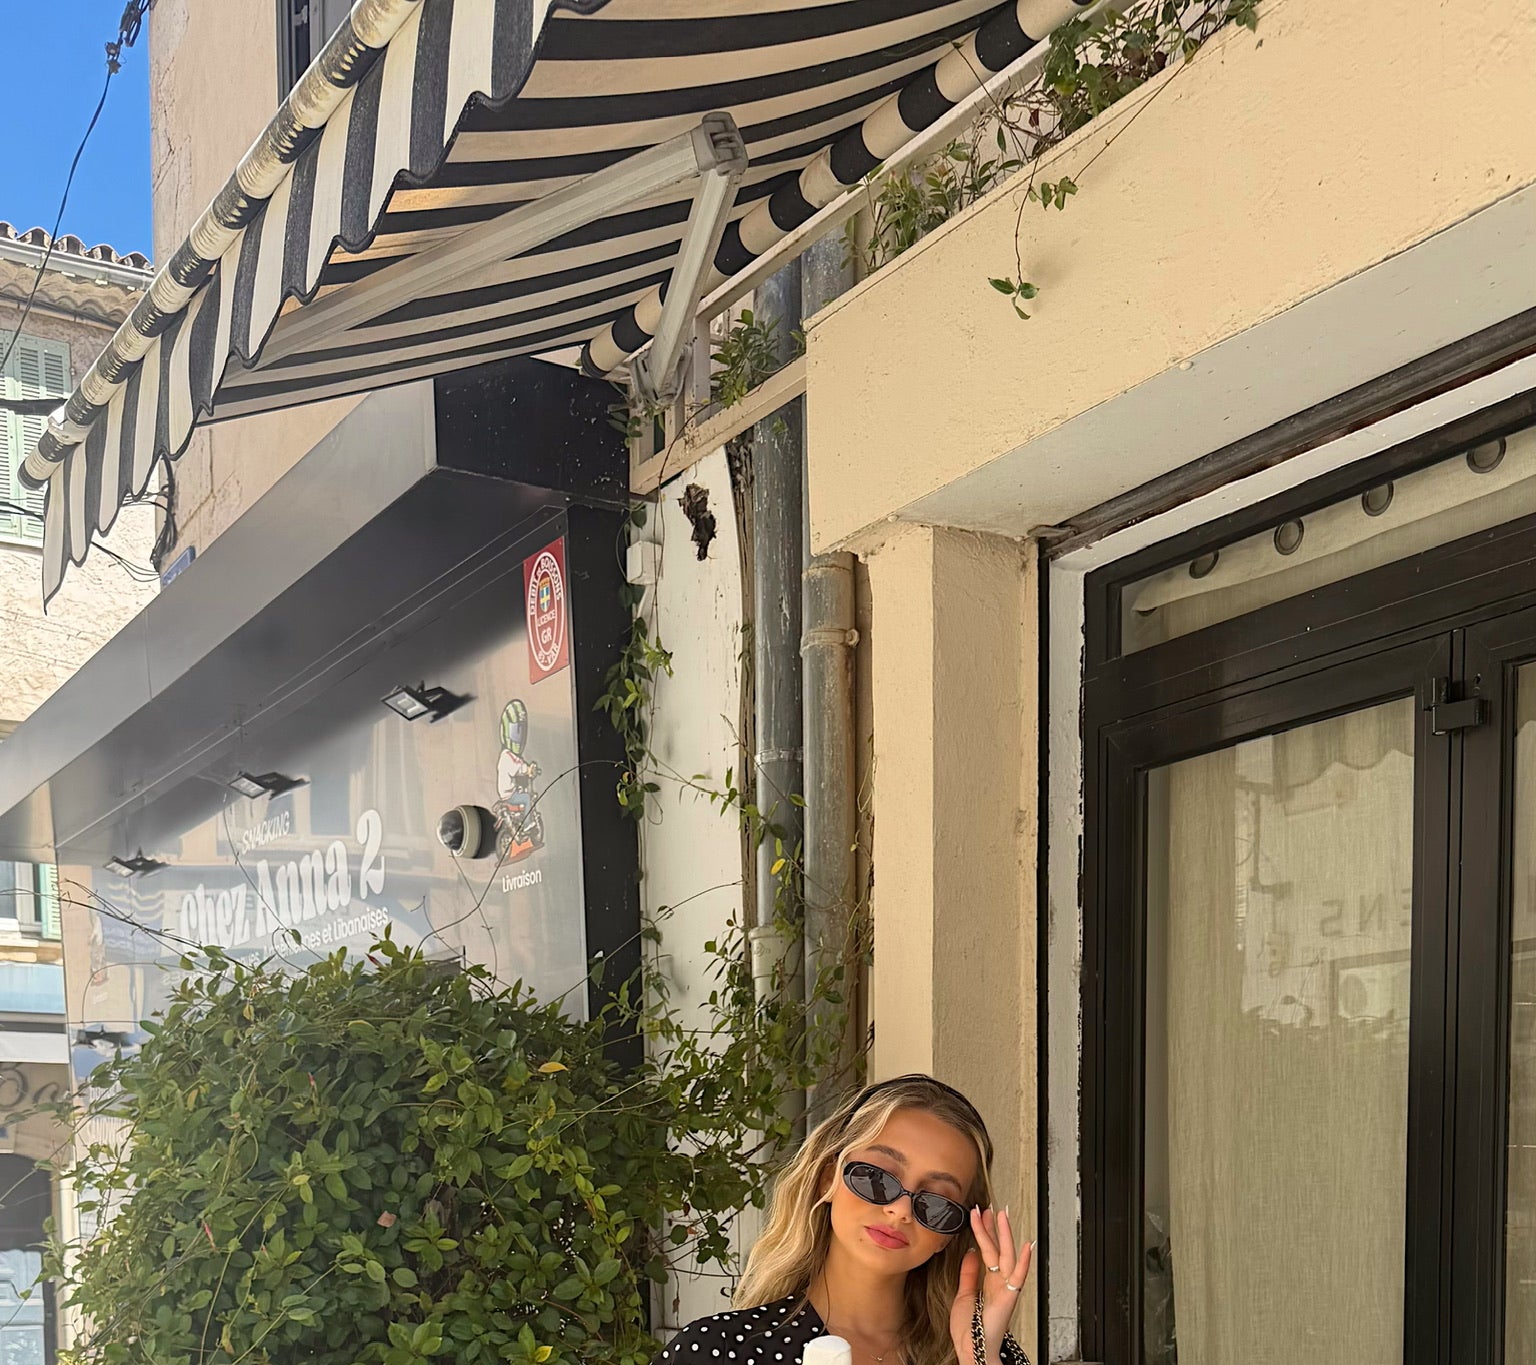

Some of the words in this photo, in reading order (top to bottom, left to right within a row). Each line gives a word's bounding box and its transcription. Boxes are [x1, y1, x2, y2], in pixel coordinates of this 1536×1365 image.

[537, 609, 557, 628] LICENCE
[541, 627, 552, 645] GR
[242, 810, 290, 855] SNACKING
[256, 840, 352, 938] Anna
[356, 809, 385, 900] 2
[502, 869, 542, 893] Livraison
[322, 920, 335, 945] et
[334, 906, 389, 941] Libanaises
